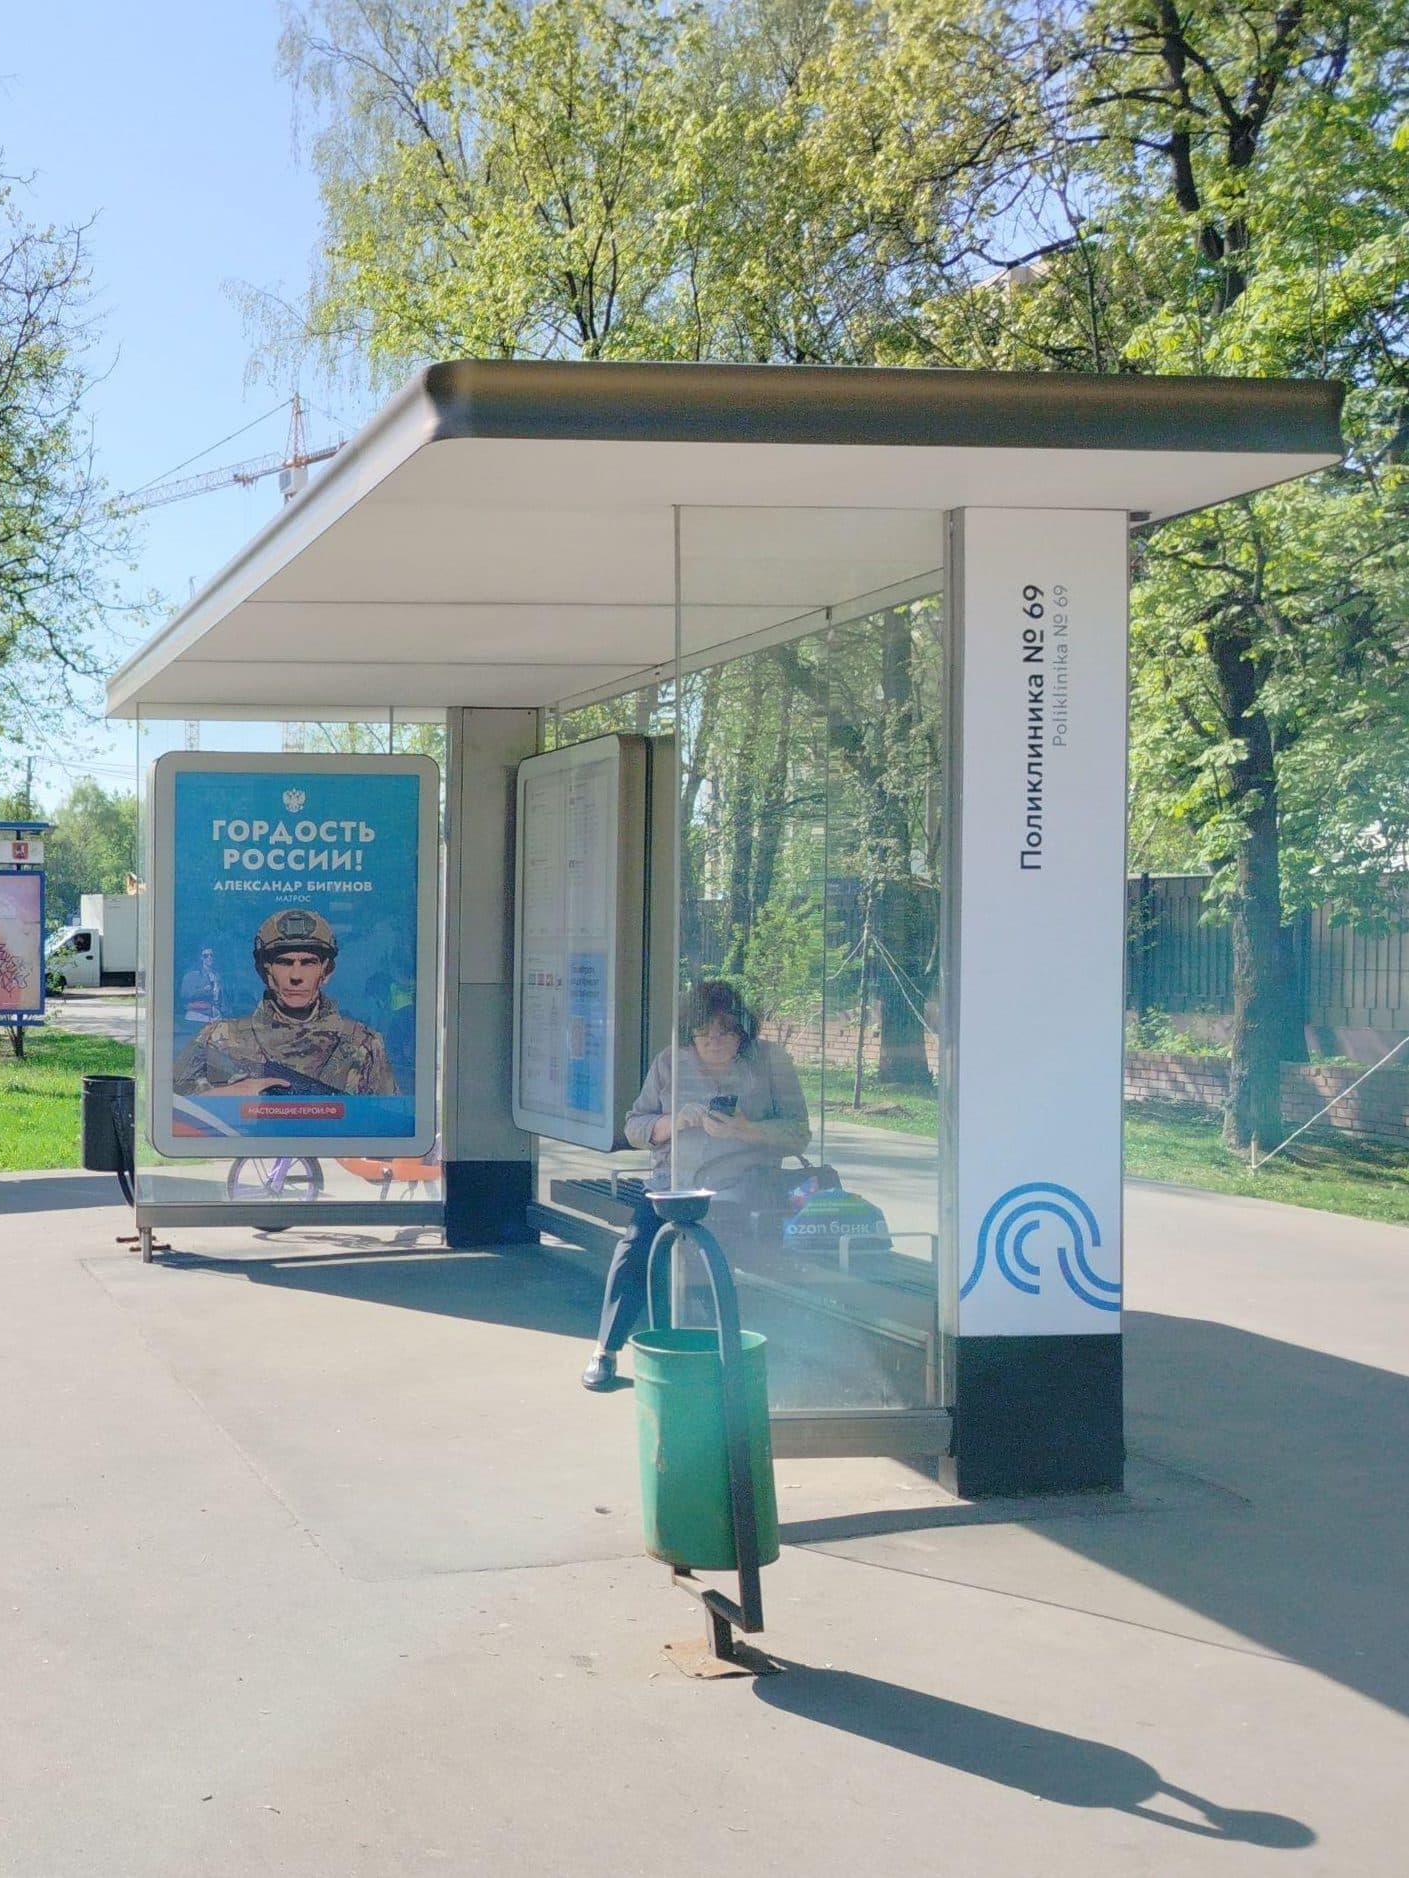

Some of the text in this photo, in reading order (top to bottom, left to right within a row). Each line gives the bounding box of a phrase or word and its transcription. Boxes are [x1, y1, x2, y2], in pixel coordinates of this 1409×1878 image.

[1052, 585, 1068, 747] Poliklinika № 69
[1020, 584, 1045, 870] Поликлиника № 69
[212, 820, 376, 845] ГОРДОСТЬ
[223, 848, 363, 871] РОССИИ!
[214, 880, 373, 892] АЛЕКСАНДР БИГУНОВ
[275, 895, 311, 903] МАТРОС
[788, 1223, 826, 1235] ozon
